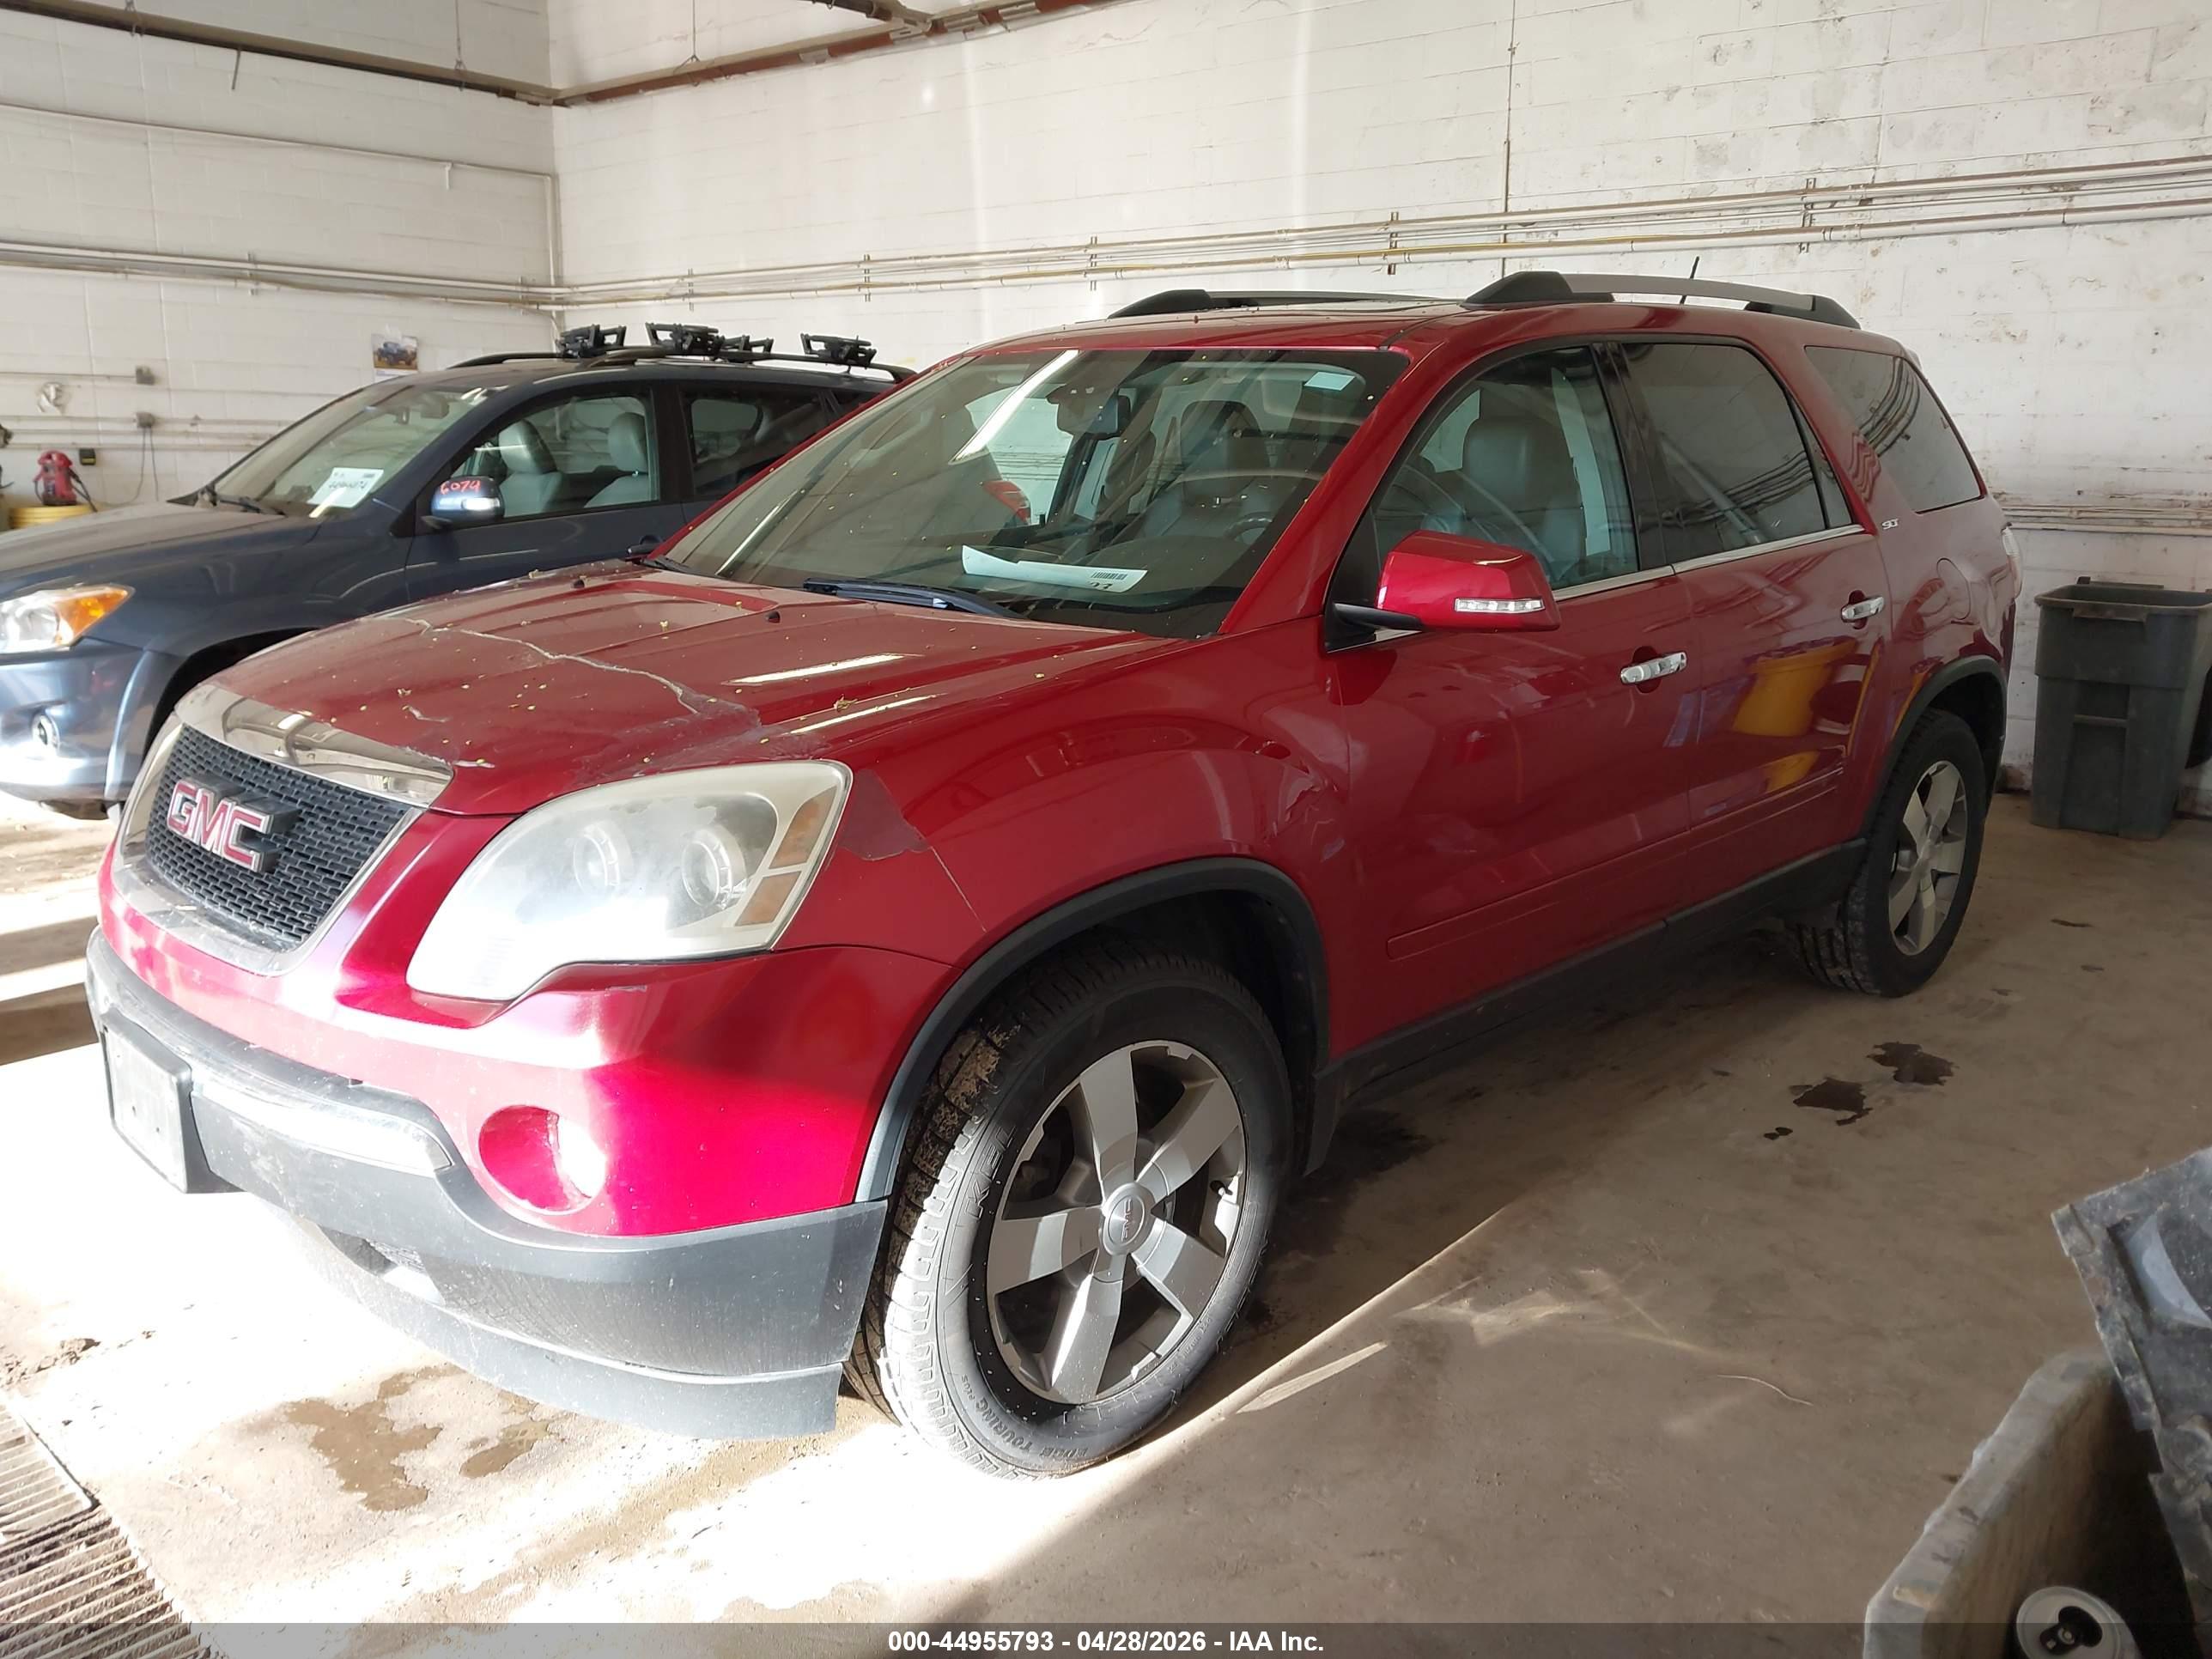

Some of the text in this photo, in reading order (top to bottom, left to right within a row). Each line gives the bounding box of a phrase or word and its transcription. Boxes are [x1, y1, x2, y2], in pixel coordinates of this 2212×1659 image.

[440, 479, 481, 495] 6074
[167, 779, 274, 873] GMC
[961, 1374, 976, 1401] PLUS
[975, 1396, 1034, 1452] TOURING
